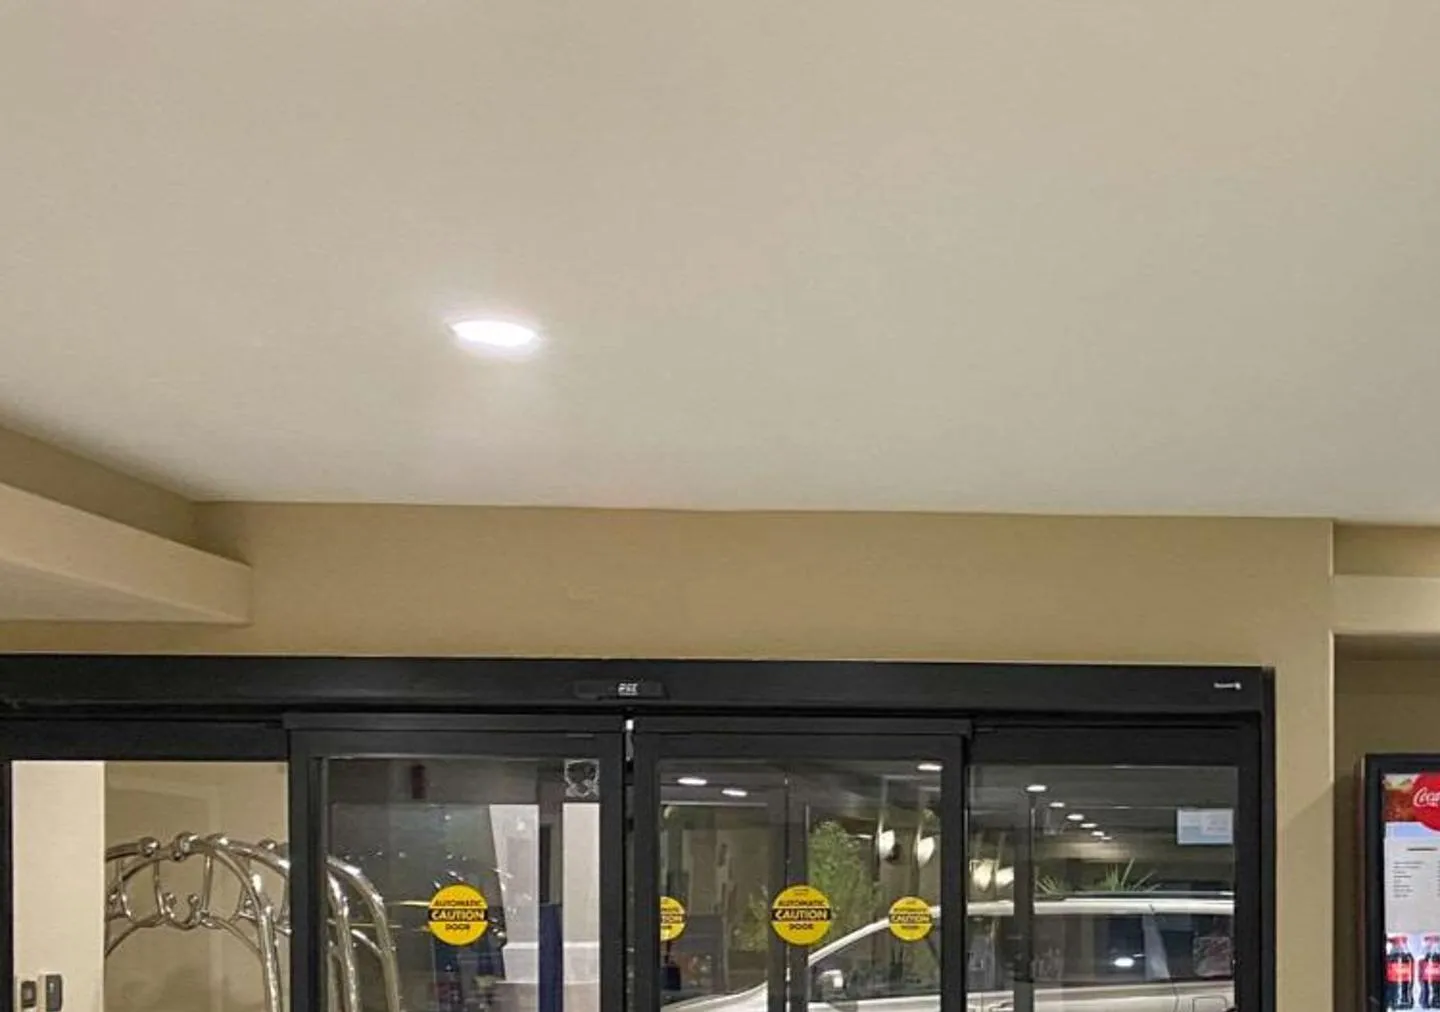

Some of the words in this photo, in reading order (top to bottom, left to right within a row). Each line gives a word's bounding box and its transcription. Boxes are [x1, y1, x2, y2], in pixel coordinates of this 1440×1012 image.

[778, 899, 826, 907] AUTOMATIC
[431, 910, 485, 921] CAUTION
[775, 909, 827, 920] CAUTION
